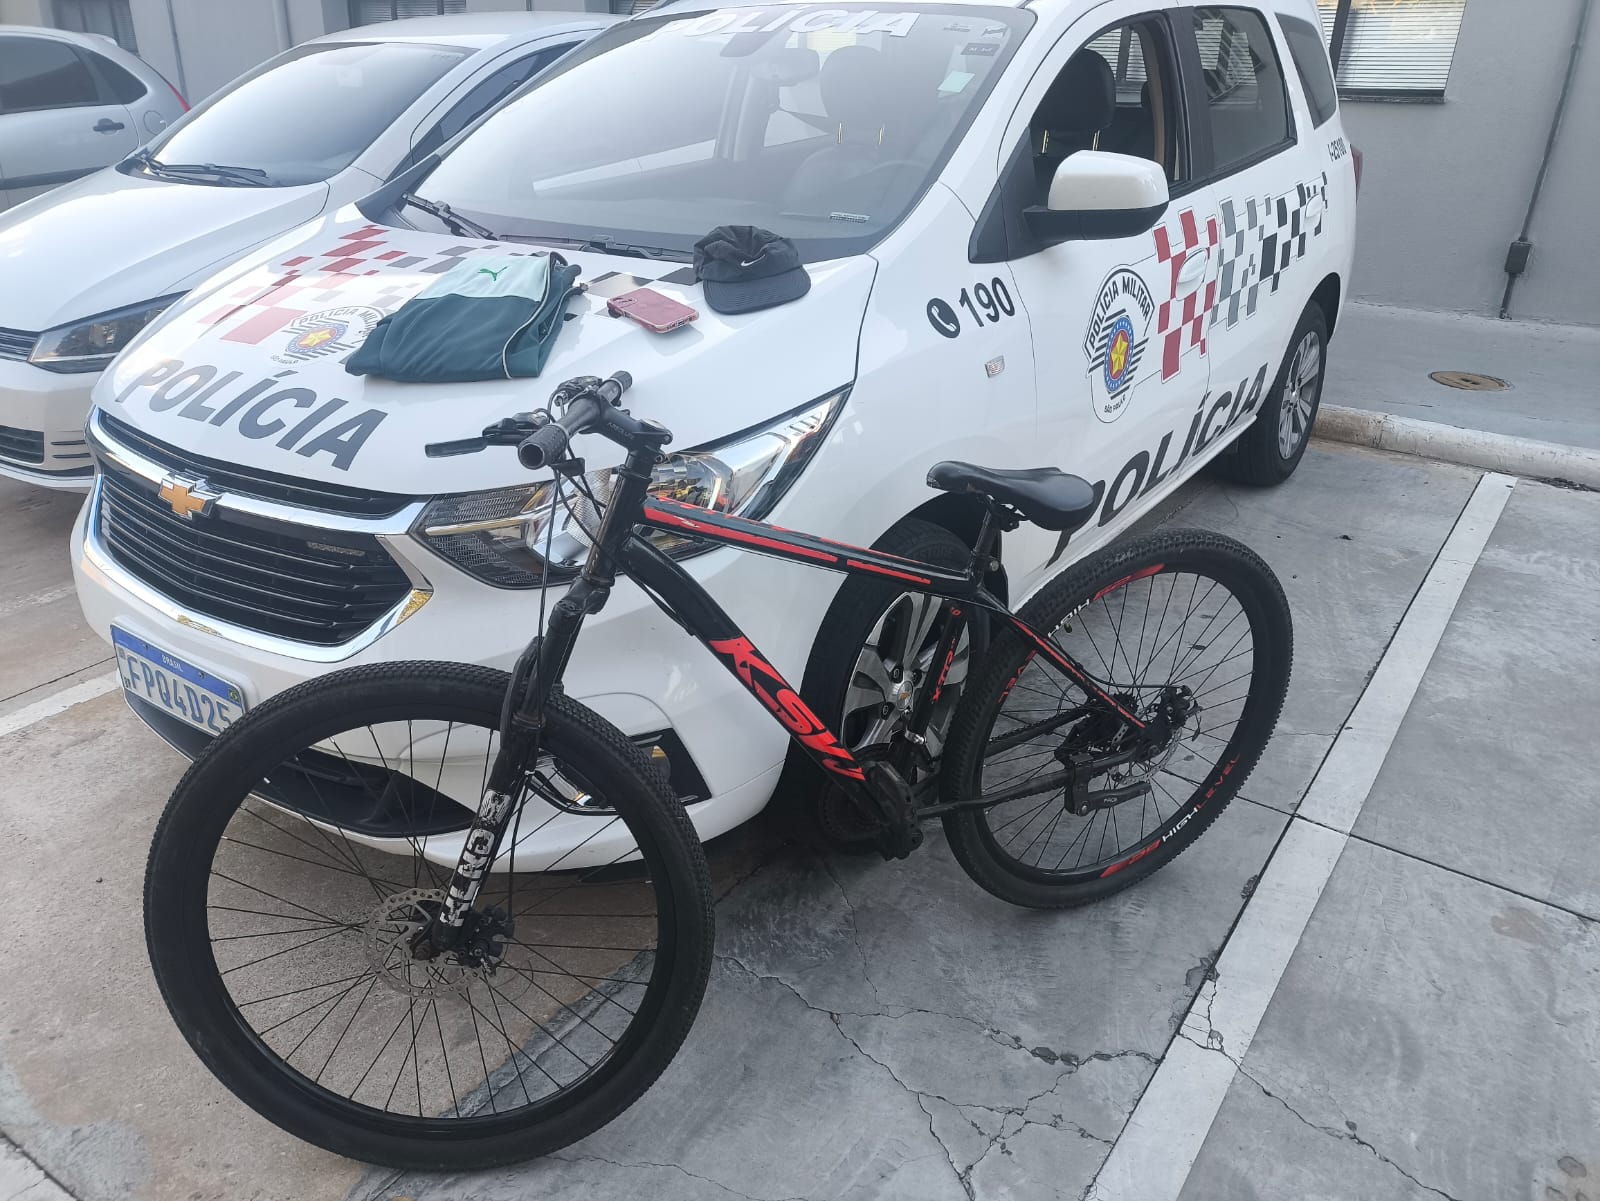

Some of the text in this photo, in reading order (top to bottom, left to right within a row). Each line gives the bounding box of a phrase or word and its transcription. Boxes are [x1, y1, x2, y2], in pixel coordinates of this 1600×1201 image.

[959, 277, 1015, 328] 190
[1122, 275, 1151, 321] MILITAR
[114, 359, 388, 471] POLÍCIA
[161, 654, 184, 673] BRASIL
[127, 655, 232, 733] FPQ4D25
